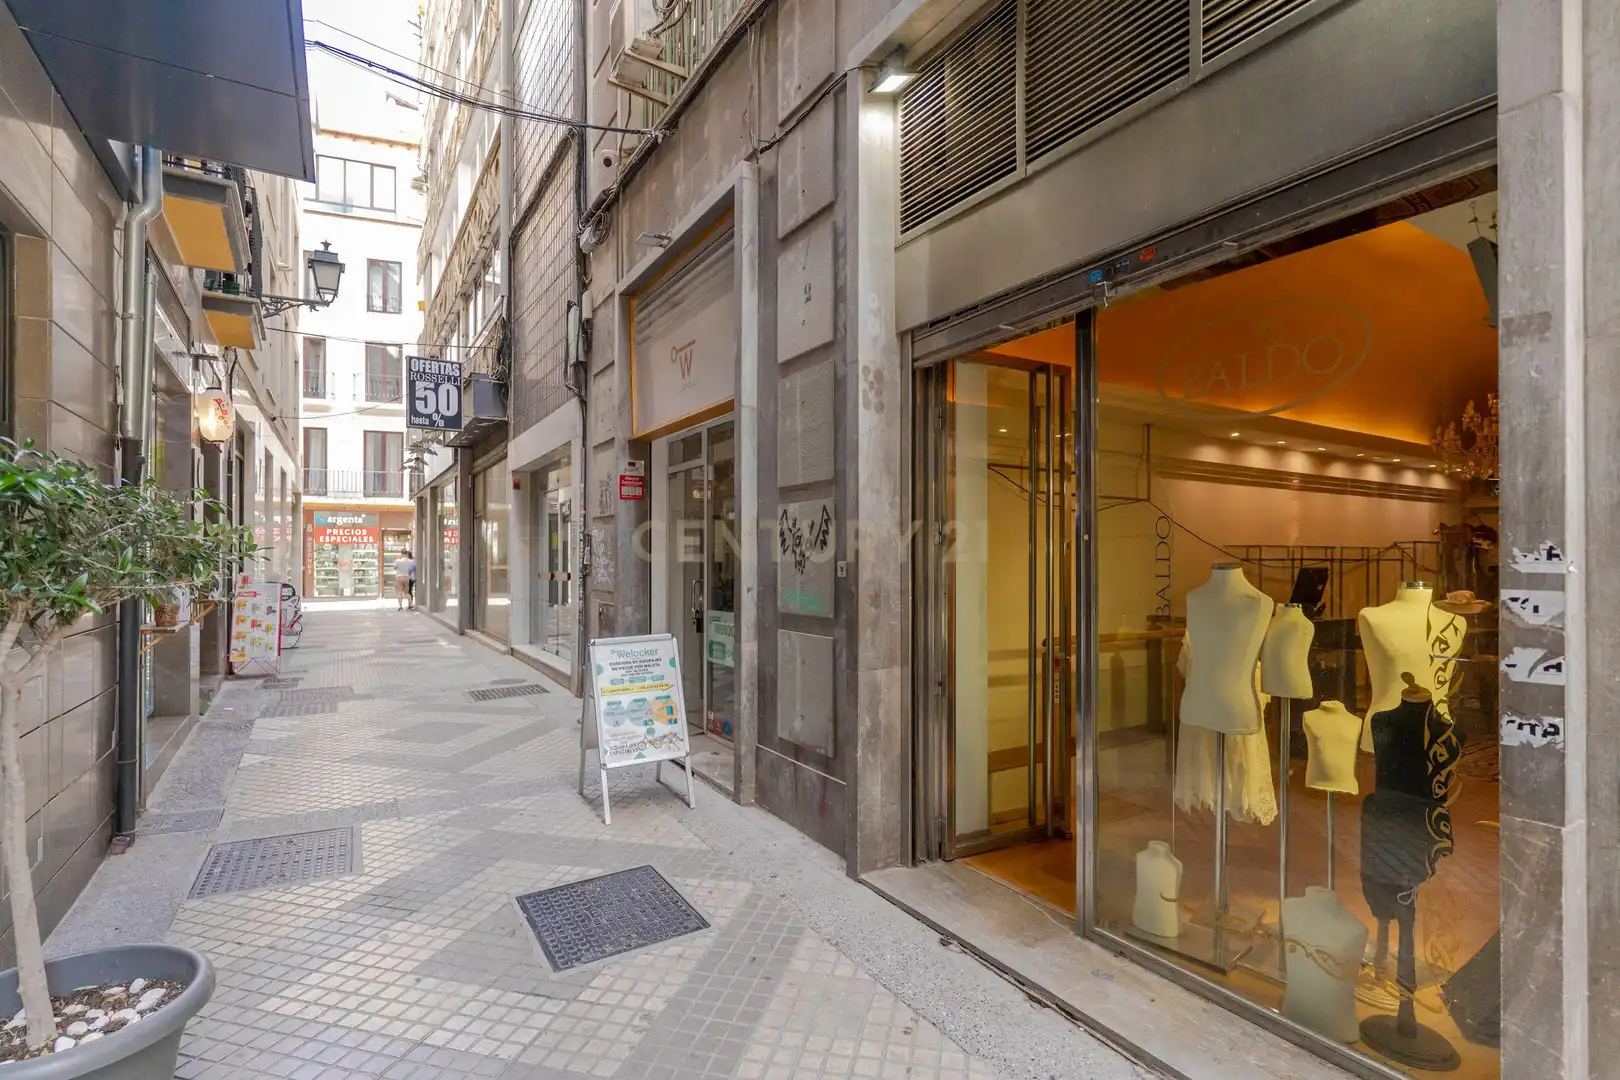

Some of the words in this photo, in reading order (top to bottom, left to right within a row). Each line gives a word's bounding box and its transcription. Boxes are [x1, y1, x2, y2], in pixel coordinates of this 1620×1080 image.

[411, 358, 460, 377] OFERTAS
[410, 371, 461, 386] ROSSELLI
[415, 381, 458, 417] 50
[411, 415, 430, 425] hasta
[432, 412, 444, 427] %
[327, 515, 363, 525] argenta
[319, 535, 374, 543] ESPECIALES
[1155, 516, 1171, 617] BALDO
